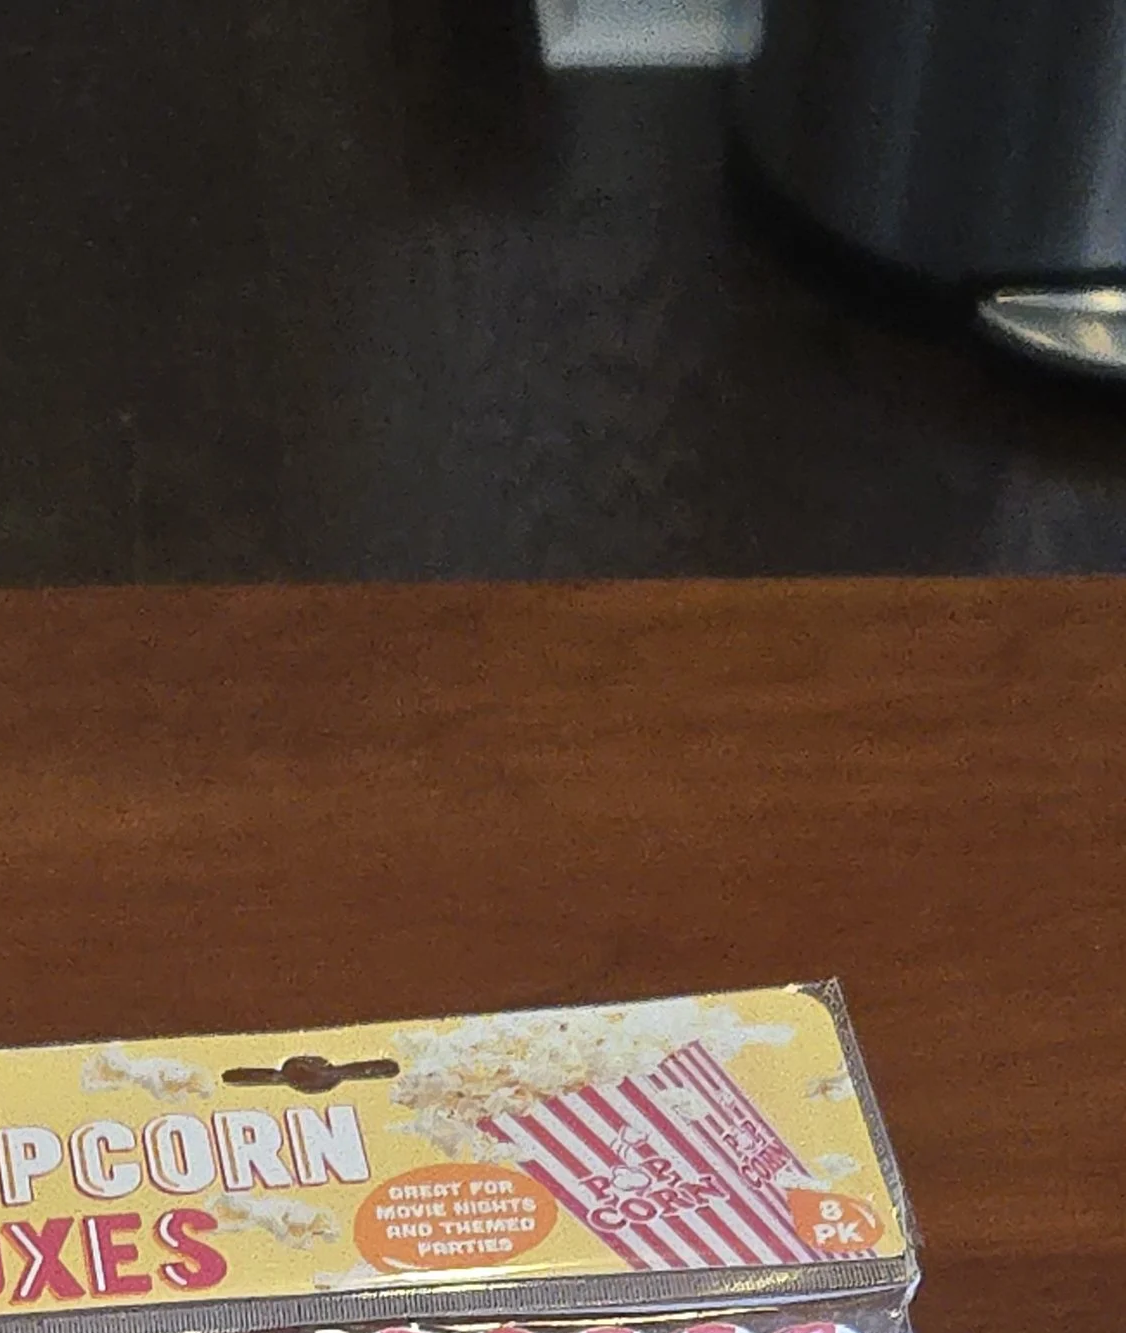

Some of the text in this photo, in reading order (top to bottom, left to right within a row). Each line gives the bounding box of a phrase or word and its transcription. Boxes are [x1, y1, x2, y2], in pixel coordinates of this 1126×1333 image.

[389, 1180, 515, 1200] GREAT FOR
[376, 1196, 537, 1221] MOVIE NIGHTS
[587, 1175, 727, 1233] CORN
[819, 1200, 843, 1222] 8
[386, 1217, 536, 1240] AND THEMED
[812, 1222, 865, 1244] PK
[417, 1237, 514, 1258] PARTIES
